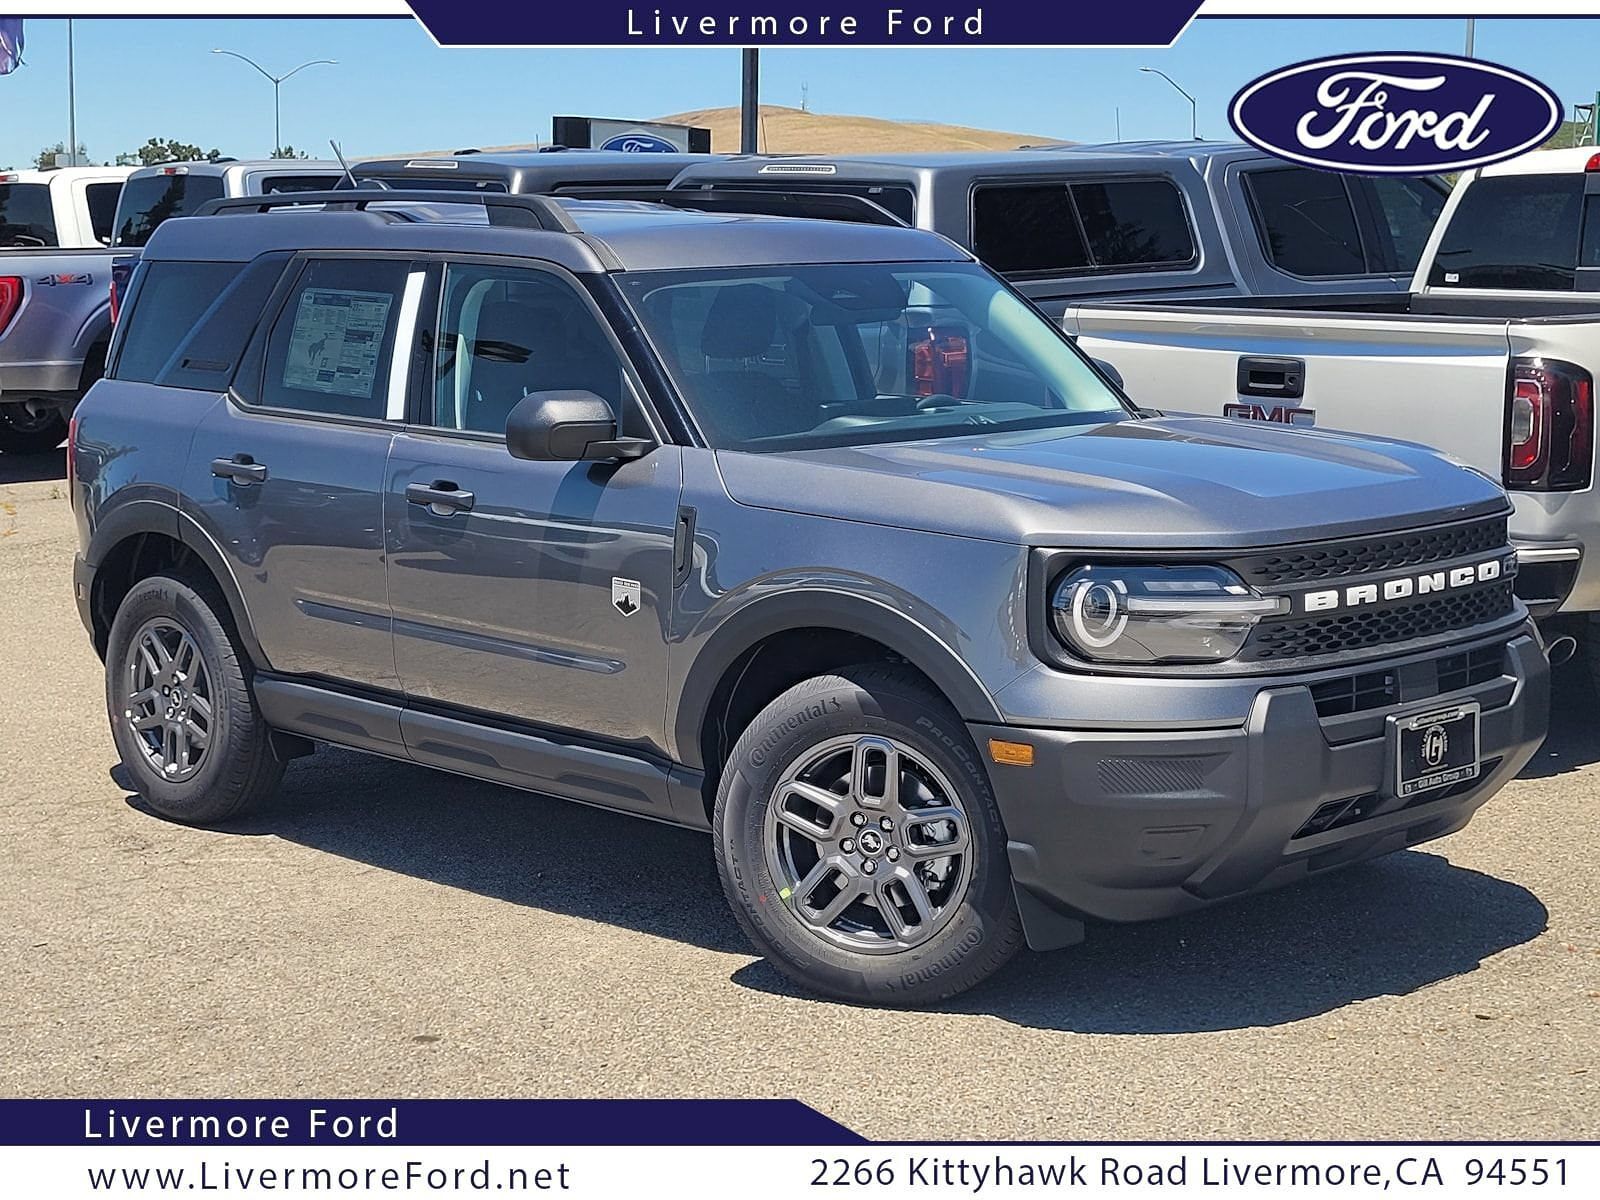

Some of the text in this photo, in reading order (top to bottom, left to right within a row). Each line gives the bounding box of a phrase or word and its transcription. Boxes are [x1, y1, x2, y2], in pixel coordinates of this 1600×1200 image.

[1222, 403, 1317, 427] GMC
[1304, 560, 1500, 612] BRONCO
[749, 697, 828, 769] Continental
[900, 926, 984, 991] Continental
